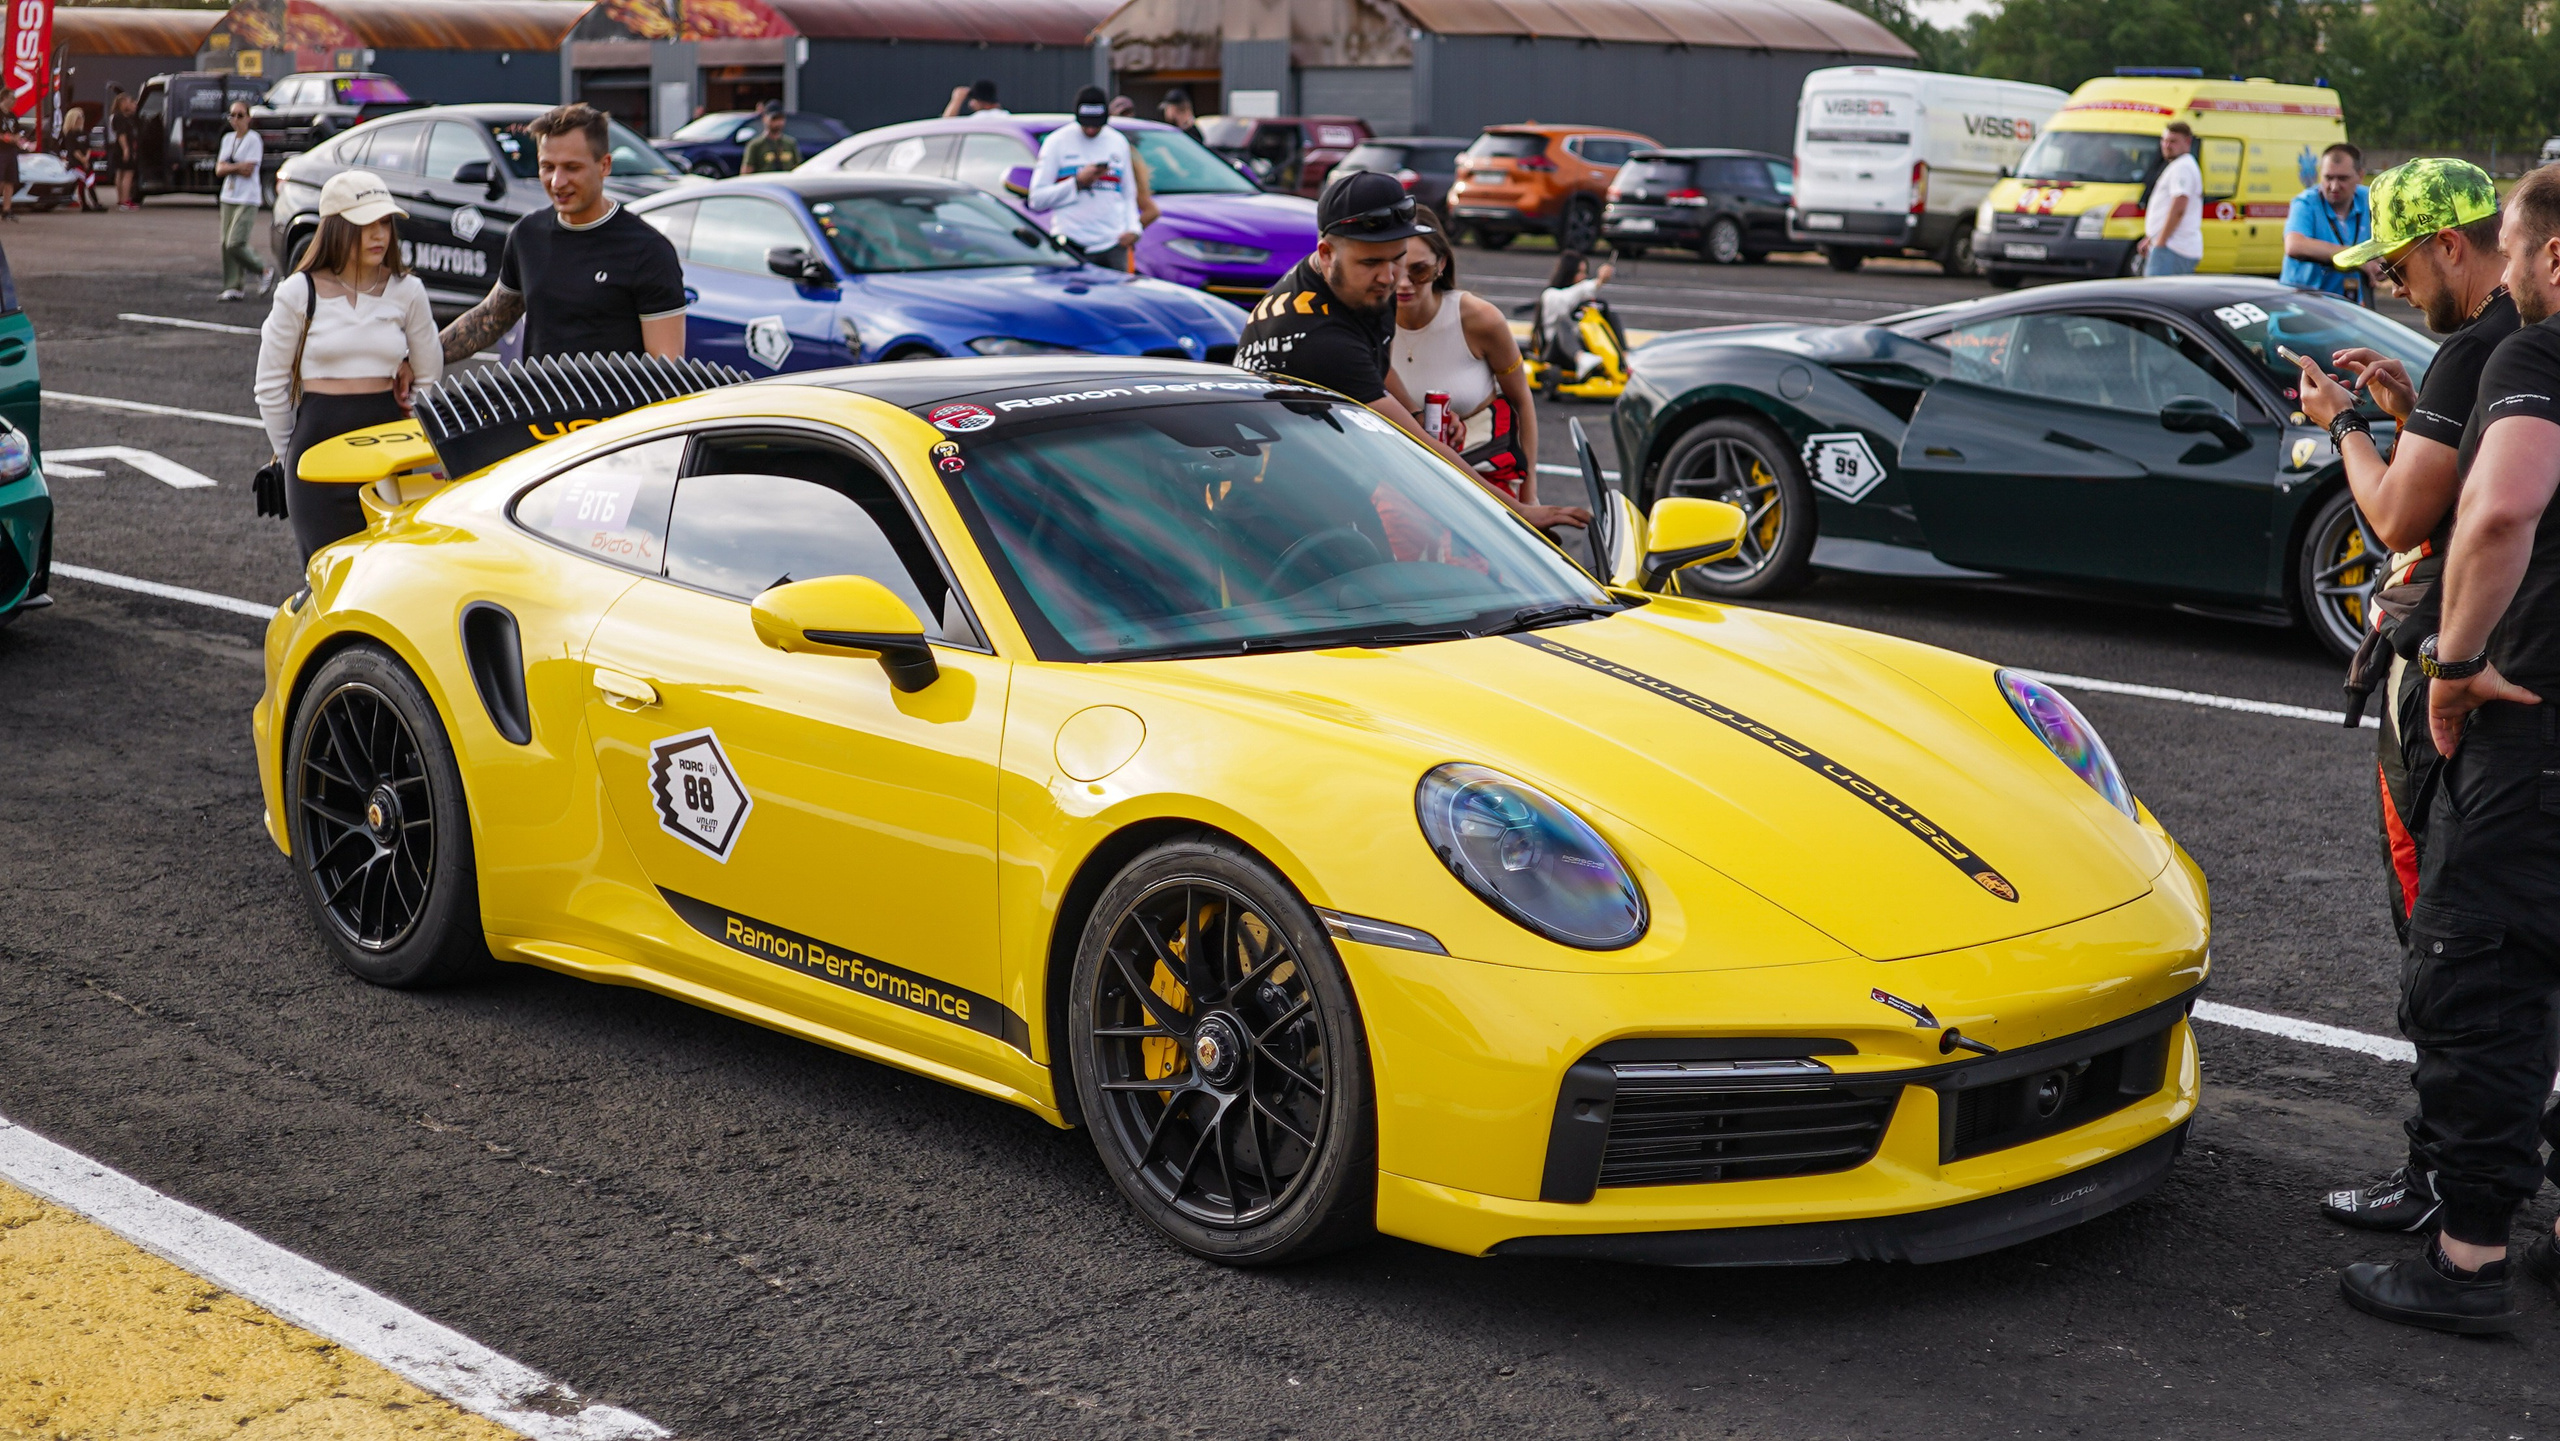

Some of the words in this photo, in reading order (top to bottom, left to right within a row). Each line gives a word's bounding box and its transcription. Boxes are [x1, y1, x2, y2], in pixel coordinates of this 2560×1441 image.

[415, 242, 488, 278] MOTORS
[995, 387, 1132, 412] Ramon
[1835, 456, 1858, 478] 99
[577, 489, 620, 523] ВТБ
[1541, 642, 1811, 758] Performance
[678, 758, 704, 773] RDRC
[683, 774, 715, 813] 88
[700, 823, 717, 833] FEST
[1823, 764, 1970, 860] Ramon
[726, 916, 804, 964] Ramon
[807, 943, 970, 1021] Performance
[1887, 1000, 1933, 1026] Performance
